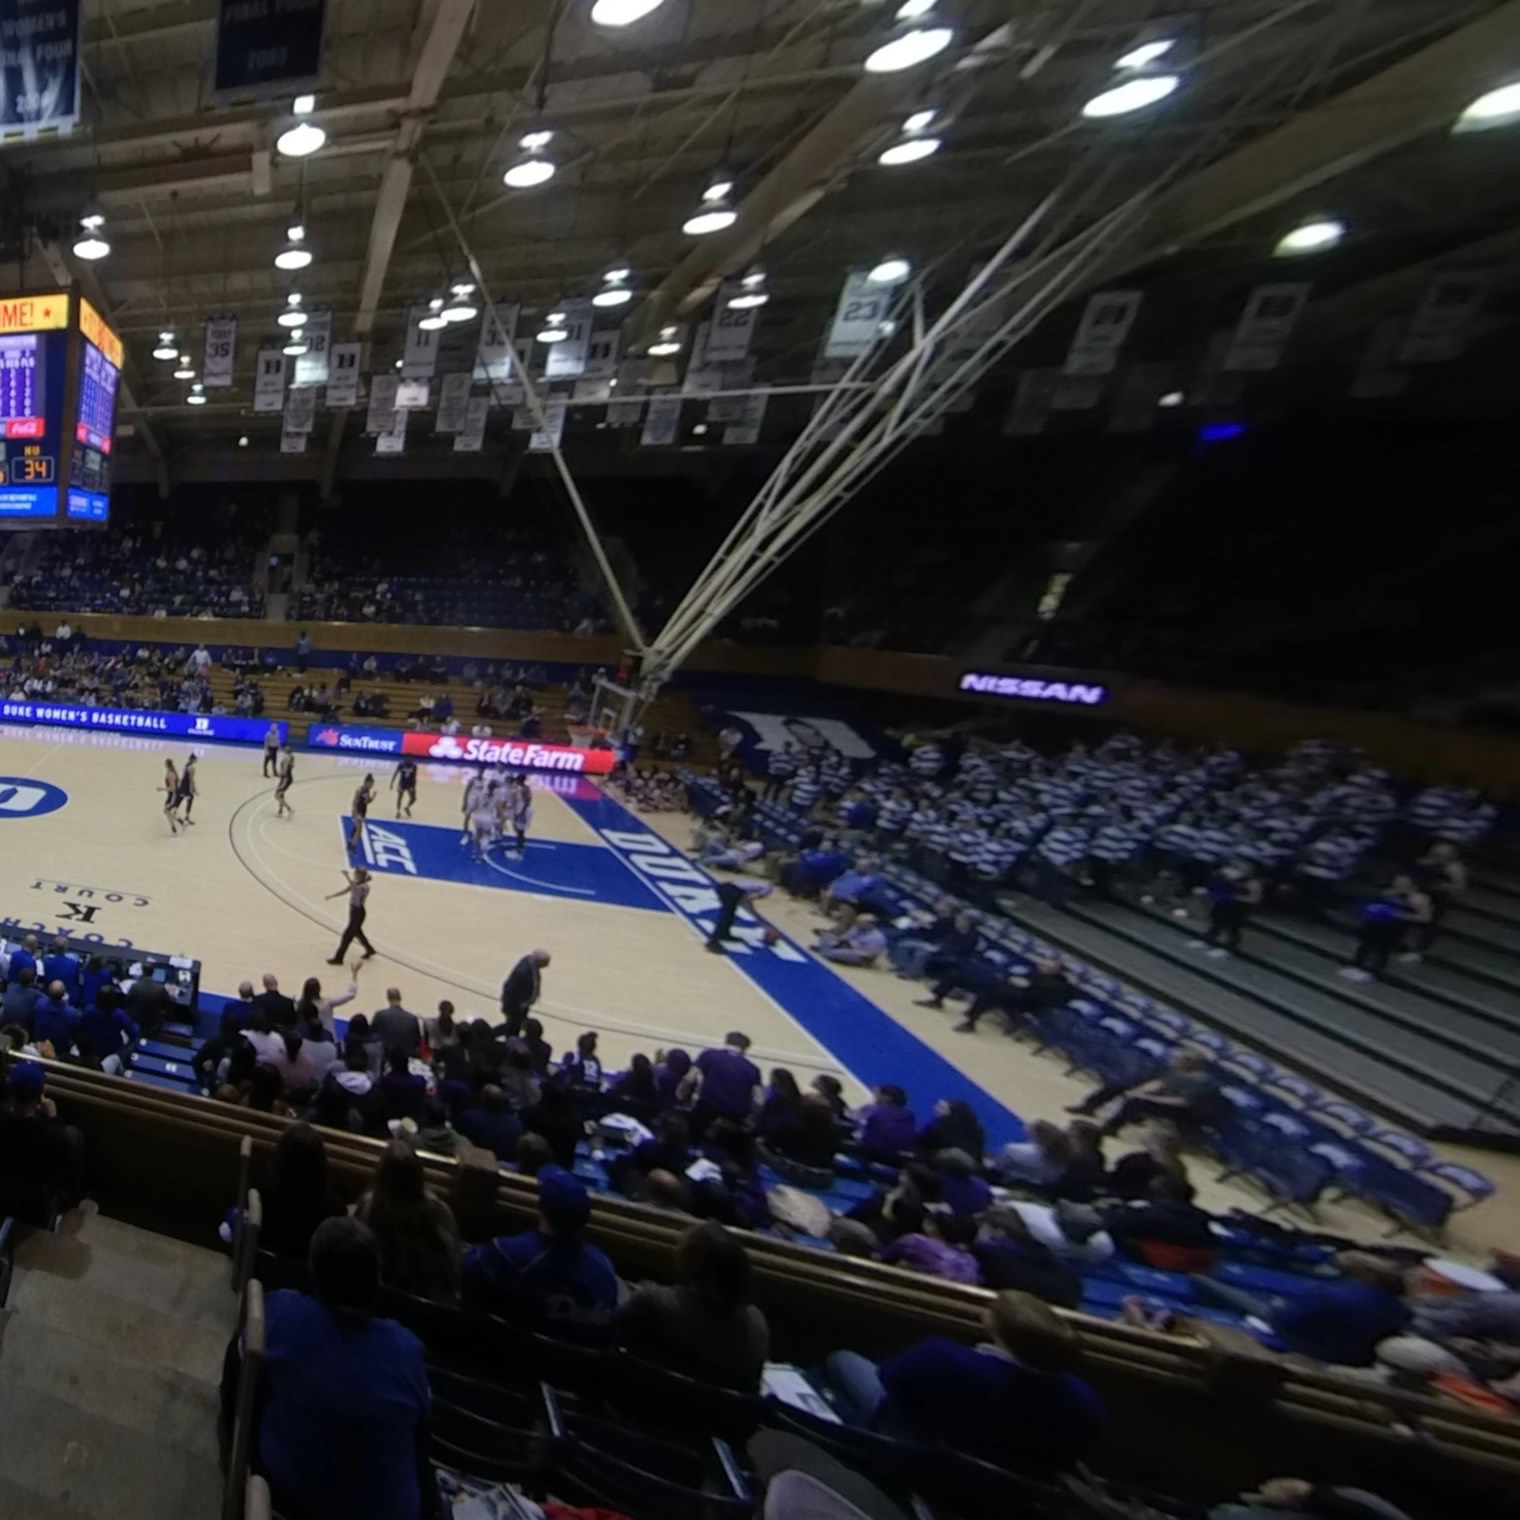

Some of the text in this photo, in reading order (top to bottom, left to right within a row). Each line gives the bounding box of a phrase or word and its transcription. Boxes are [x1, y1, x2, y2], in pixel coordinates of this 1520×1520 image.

[843, 301, 878, 321] 23
[209, 342, 231, 358] 35
[25, 458, 47, 481] 34
[960, 673, 1104, 704] NISSAN
[3, 704, 32, 717] DUKE
[36, 707, 88, 723] WOMEN'S
[92, 712, 168, 730] BASKETBALL
[368, 823, 418, 875] ACC
[30, 880, 151, 908] COURT
[54, 901, 103, 925] K
[1, 916, 134, 949] COACH
